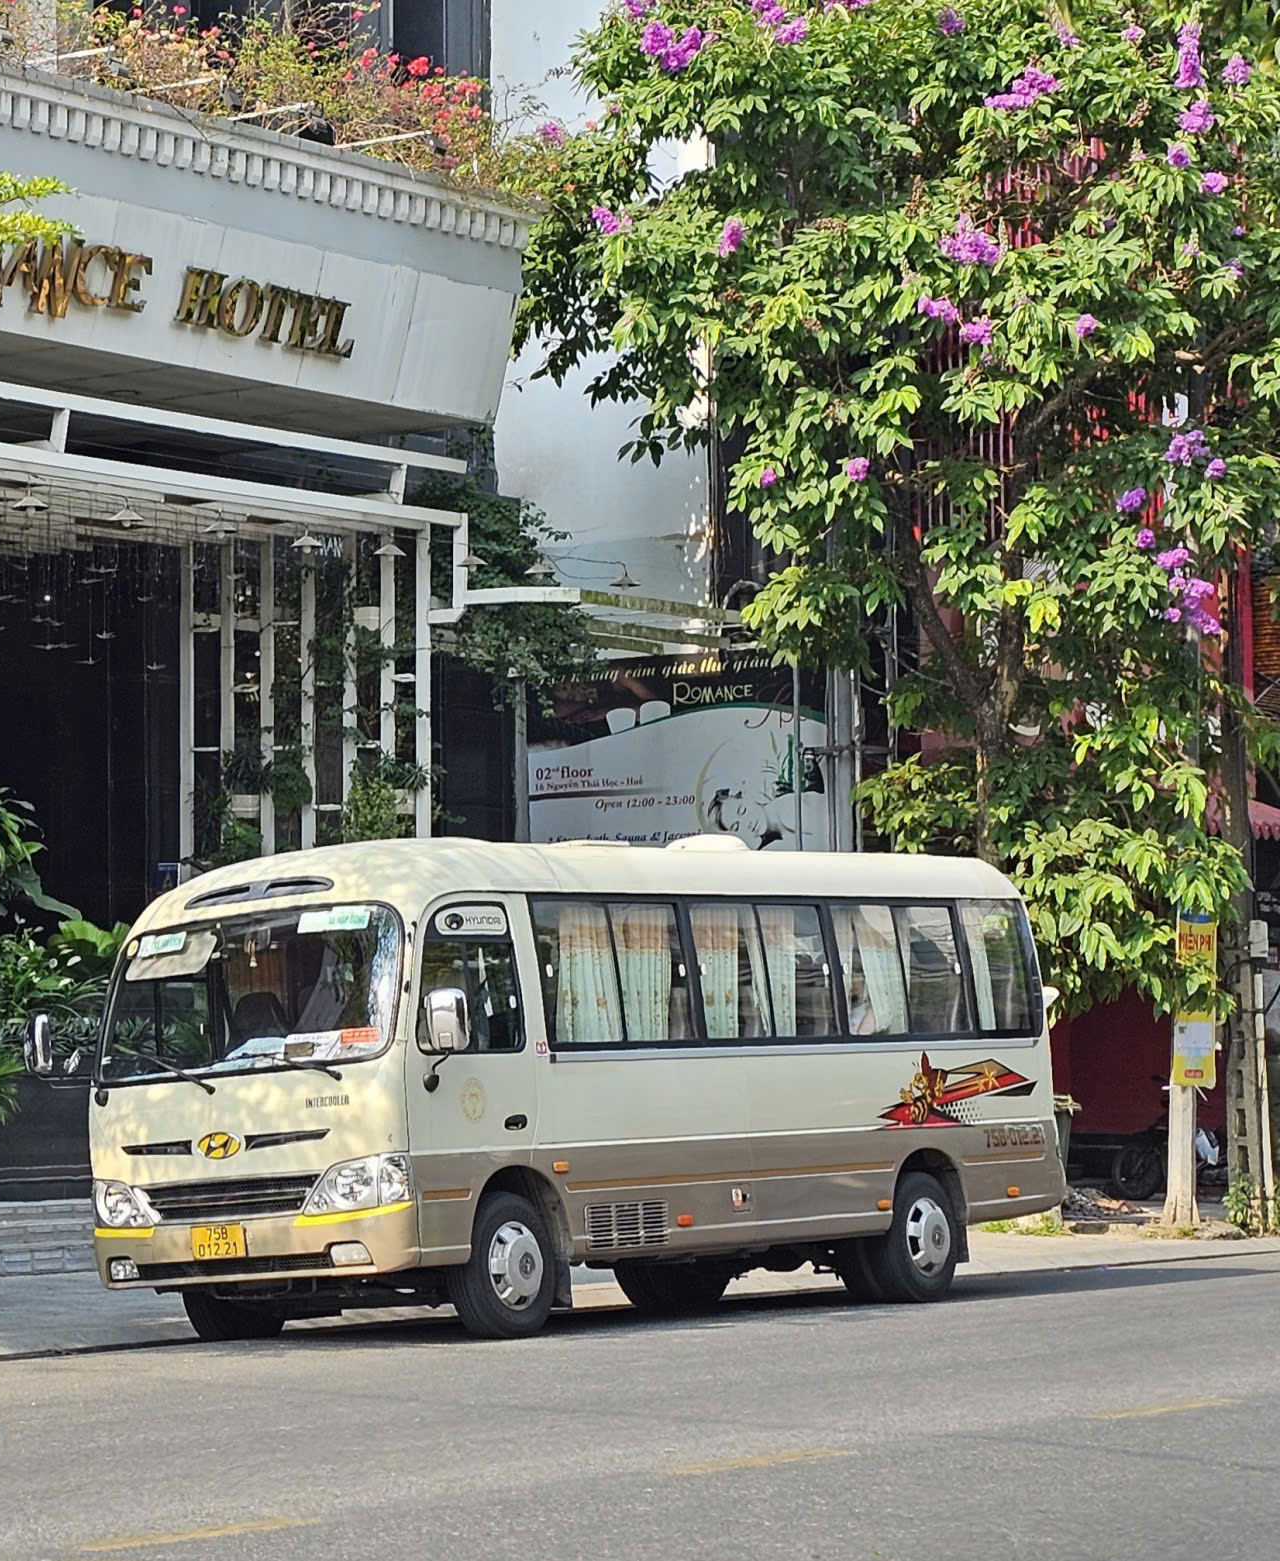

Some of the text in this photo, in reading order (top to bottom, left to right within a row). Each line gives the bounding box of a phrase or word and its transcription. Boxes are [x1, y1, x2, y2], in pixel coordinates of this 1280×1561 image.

[173, 265, 356, 358] HOTEL
[673, 682, 753, 705] ROMANCE
[561, 765, 594, 779] floor
[535, 783, 545, 791] 16
[595, 798, 623, 812] Open
[626, 797, 655, 808] 12:00
[665, 795, 696, 806] 23:00
[465, 916, 501, 925] HYUNDAI
[305, 1095, 350, 1109] INTERCOOLER
[206, 1226, 228, 1241] 75B
[198, 1241, 238, 1257] 012.21
